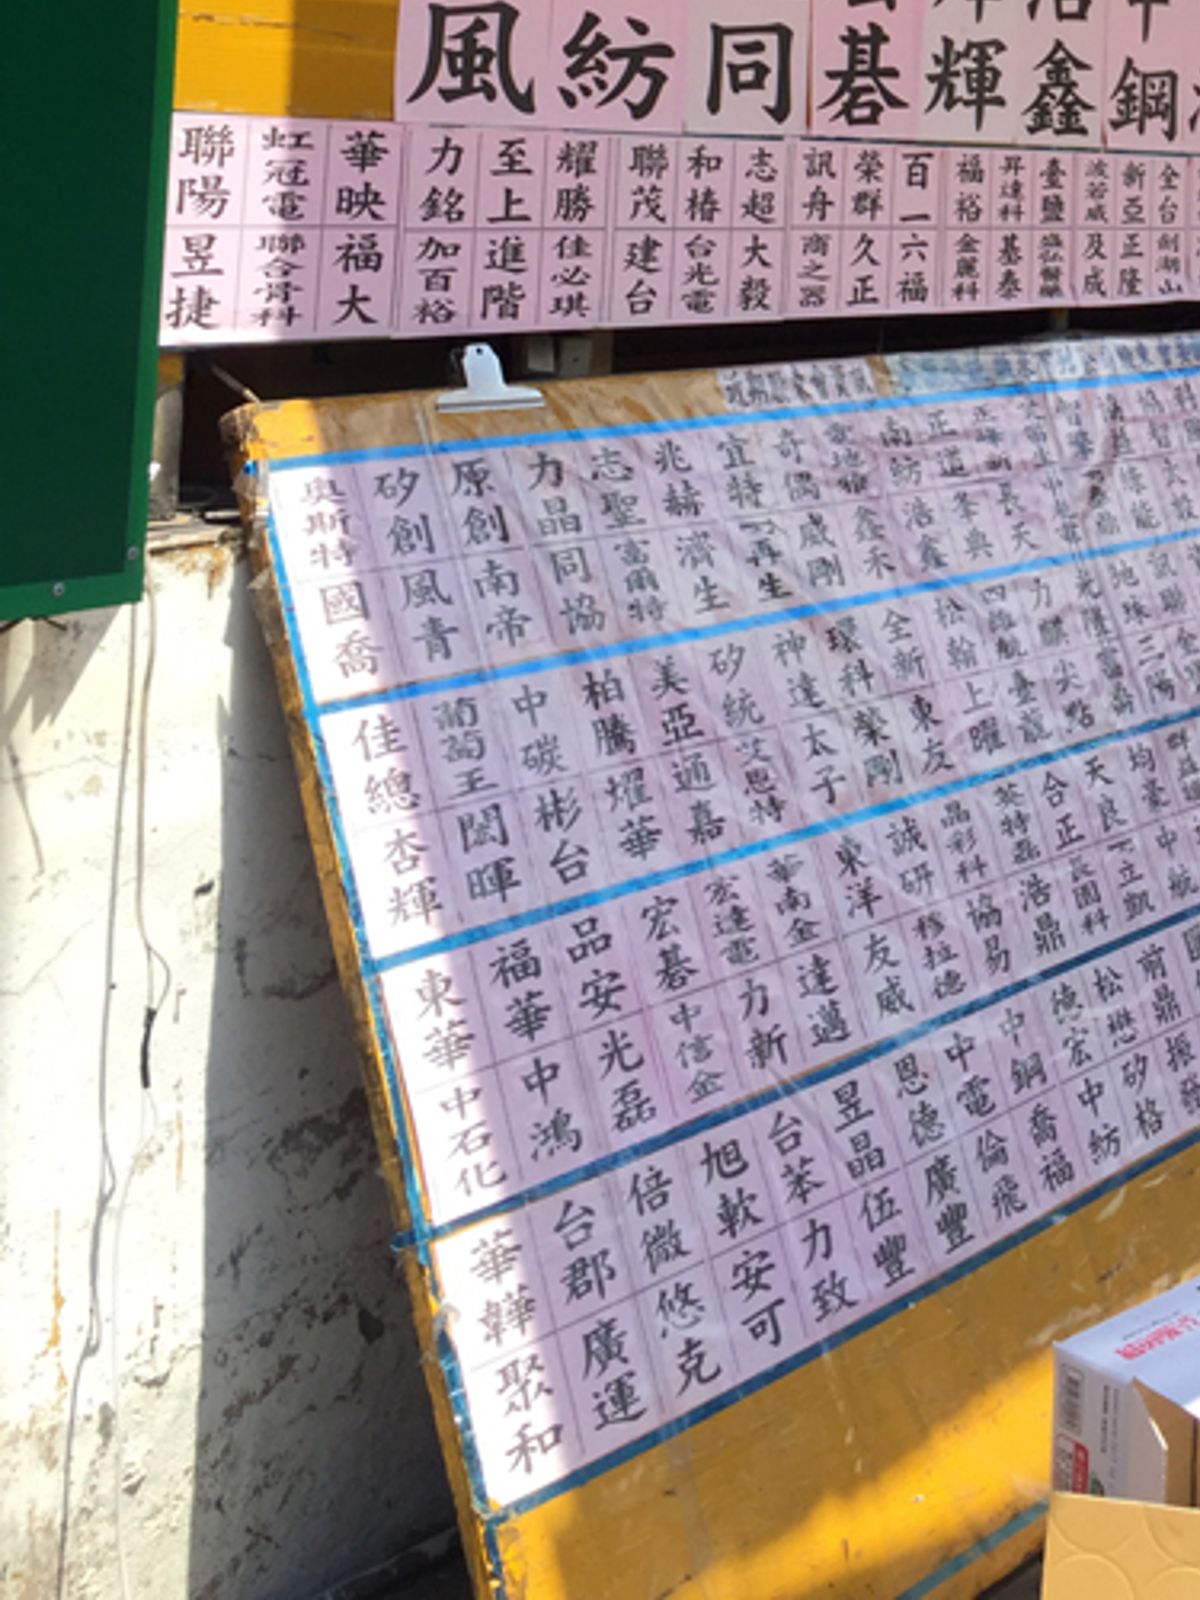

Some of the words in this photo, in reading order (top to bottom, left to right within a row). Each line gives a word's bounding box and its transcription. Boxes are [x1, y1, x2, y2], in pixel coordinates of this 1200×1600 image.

[176, 125, 234, 219] 聯陽
[336, 130, 389, 221] 華映
[419, 137, 464, 224] 力銘
[486, 138, 533, 224] 至上
[899, 152, 934, 222] 百一
[332, 233, 383, 325] 福大
[413, 236, 461, 324] 加百裕
[481, 236, 527, 320] 進階
[624, 234, 663, 315] 建台
[847, 233, 880, 306] 久正
[375, 467, 434, 554] 矽創
[529, 451, 581, 535] 力晶
[588, 447, 645, 528] 志聖
[319, 580, 387, 680] 國喬
[402, 568, 458, 660] 風青
[473, 559, 531, 645] 南帝
[883, 609, 924, 679] 全新
[582, 669, 635, 755] 柏騰
[652, 655, 703, 746] 美亞
[709, 643, 764, 727] 矽統
[774, 630, 825, 709] 神達
[351, 712, 421, 820] 佳總
[434, 697, 496, 798] 葡萄王
[512, 684, 566, 775] 中碳
[802, 723, 846, 805] 太子
[910, 694, 955, 772] 東友
[536, 788, 588, 884] 彬台
[671, 747, 725, 843] 通嘉
[1043, 771, 1084, 850] 合正
[1084, 755, 1126, 832] 天良
[376, 823, 446, 934] 杏輝
[836, 836, 880, 917] 東洋
[567, 916, 625, 1016] 品安
[641, 896, 697, 989] 宏碁
[408, 962, 479, 1077] 東華
[491, 939, 550, 1039] 福華
[740, 978, 786, 1068] 力新
[600, 1030, 655, 1130] 光磊
[669, 1002, 723, 1103] 中信金
[944, 1032, 995, 1116] 中電
[1000, 1008, 1046, 1094] 中鋼
[434, 1080, 505, 1199] 中石化
[522, 1057, 582, 1159] 中鴻
[833, 1080, 884, 1178] 昱晶
[1077, 1077, 1120, 1164] 中紡
[701, 1140, 761, 1237] 旭軟
[769, 1111, 823, 1203] 台苯
[554, 1200, 615, 1300] 台郡
[630, 1166, 689, 1273] 倍微
[861, 1173, 914, 1287] 伍豐
[732, 1250, 782, 1345] 安可
[802, 1219, 855, 1321] 力致
[494, 1352, 567, 1482] 聚和
[583, 1318, 645, 1428] 廣運
